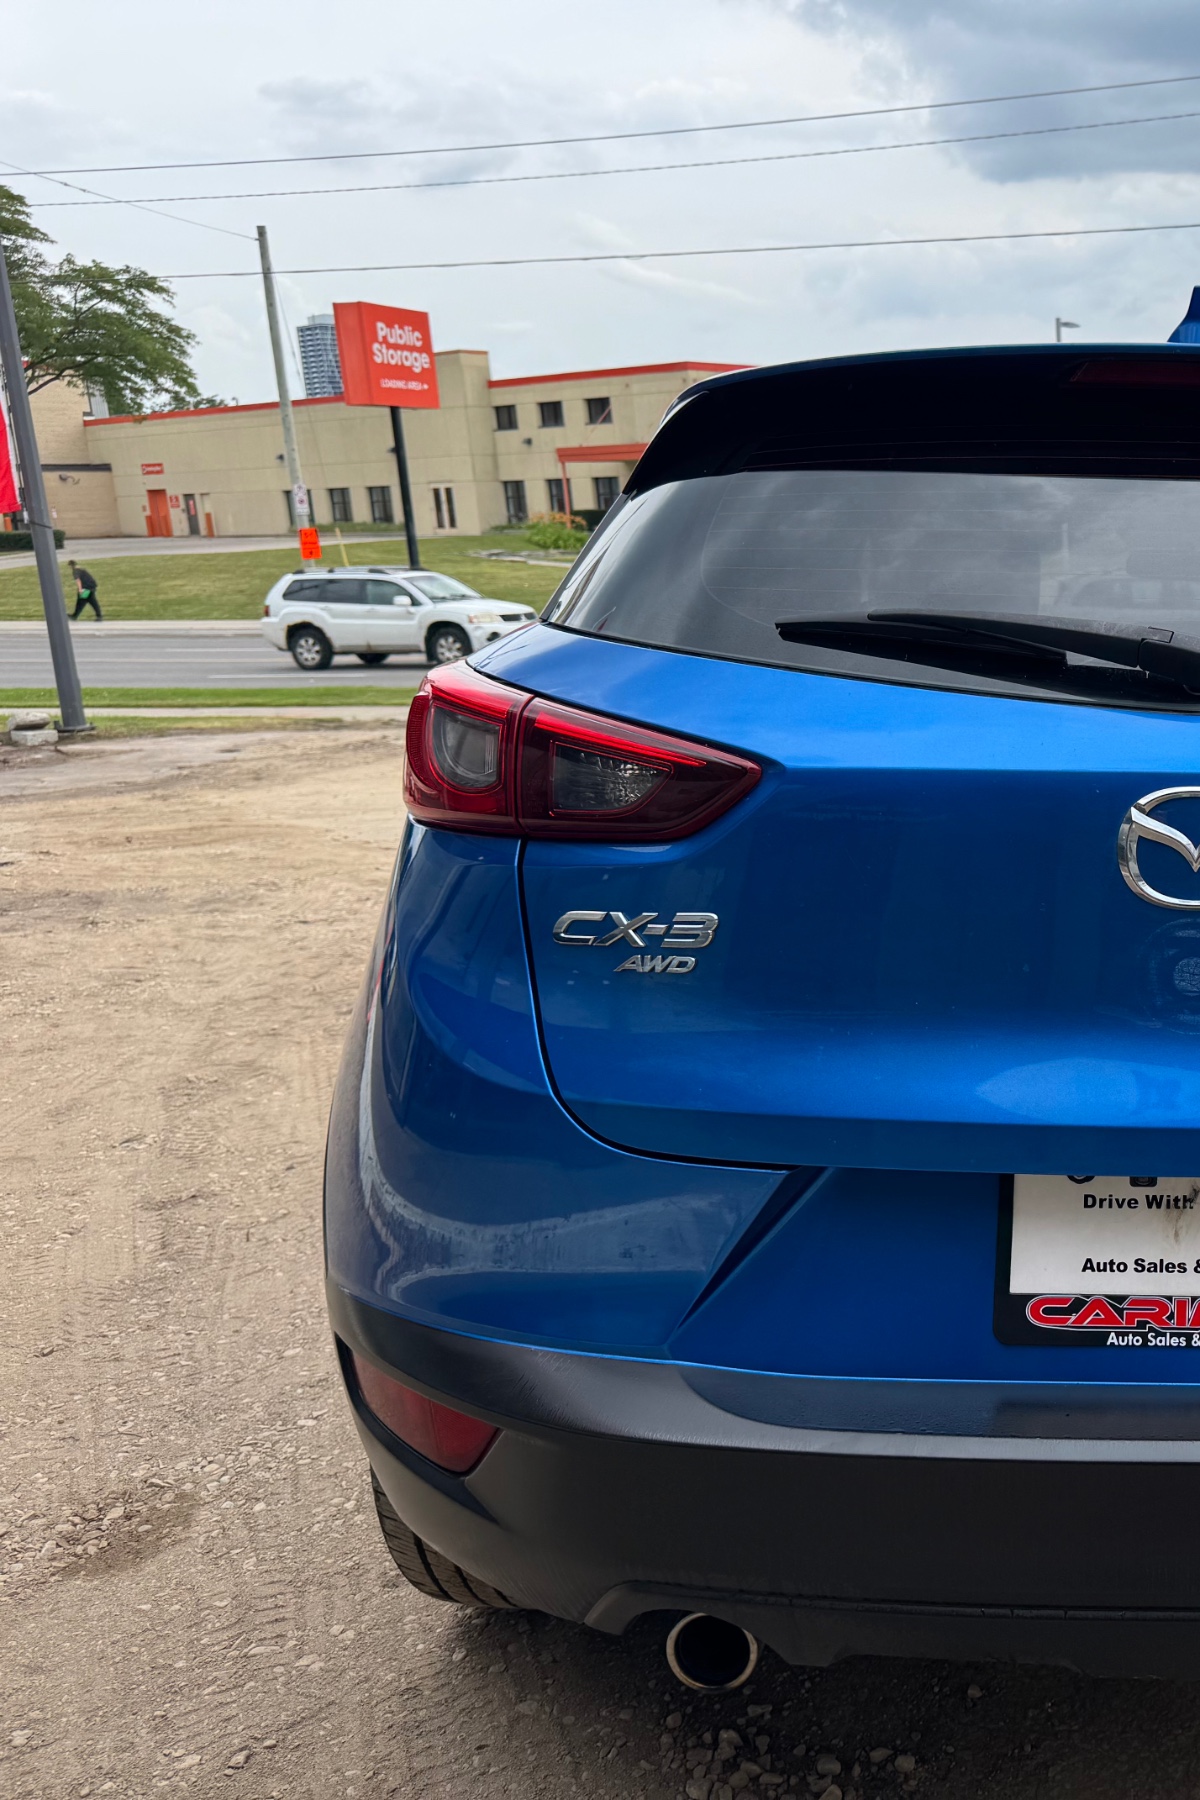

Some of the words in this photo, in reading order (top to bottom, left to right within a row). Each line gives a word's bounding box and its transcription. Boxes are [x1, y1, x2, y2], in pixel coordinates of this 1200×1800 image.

[376, 321, 423, 347] Public
[372, 342, 430, 373] Storage
[552, 910, 719, 948] CX-3
[613, 954, 696, 974] AWD
[1083, 1194, 1139, 1209] Drive
[1145, 1194, 1194, 1209] With
[1081, 1258, 1128, 1273] Auto
[1133, 1258, 1188, 1273] Sales
[1106, 1332, 1143, 1347] Auto
[1147, 1332, 1187, 1347] Sales
